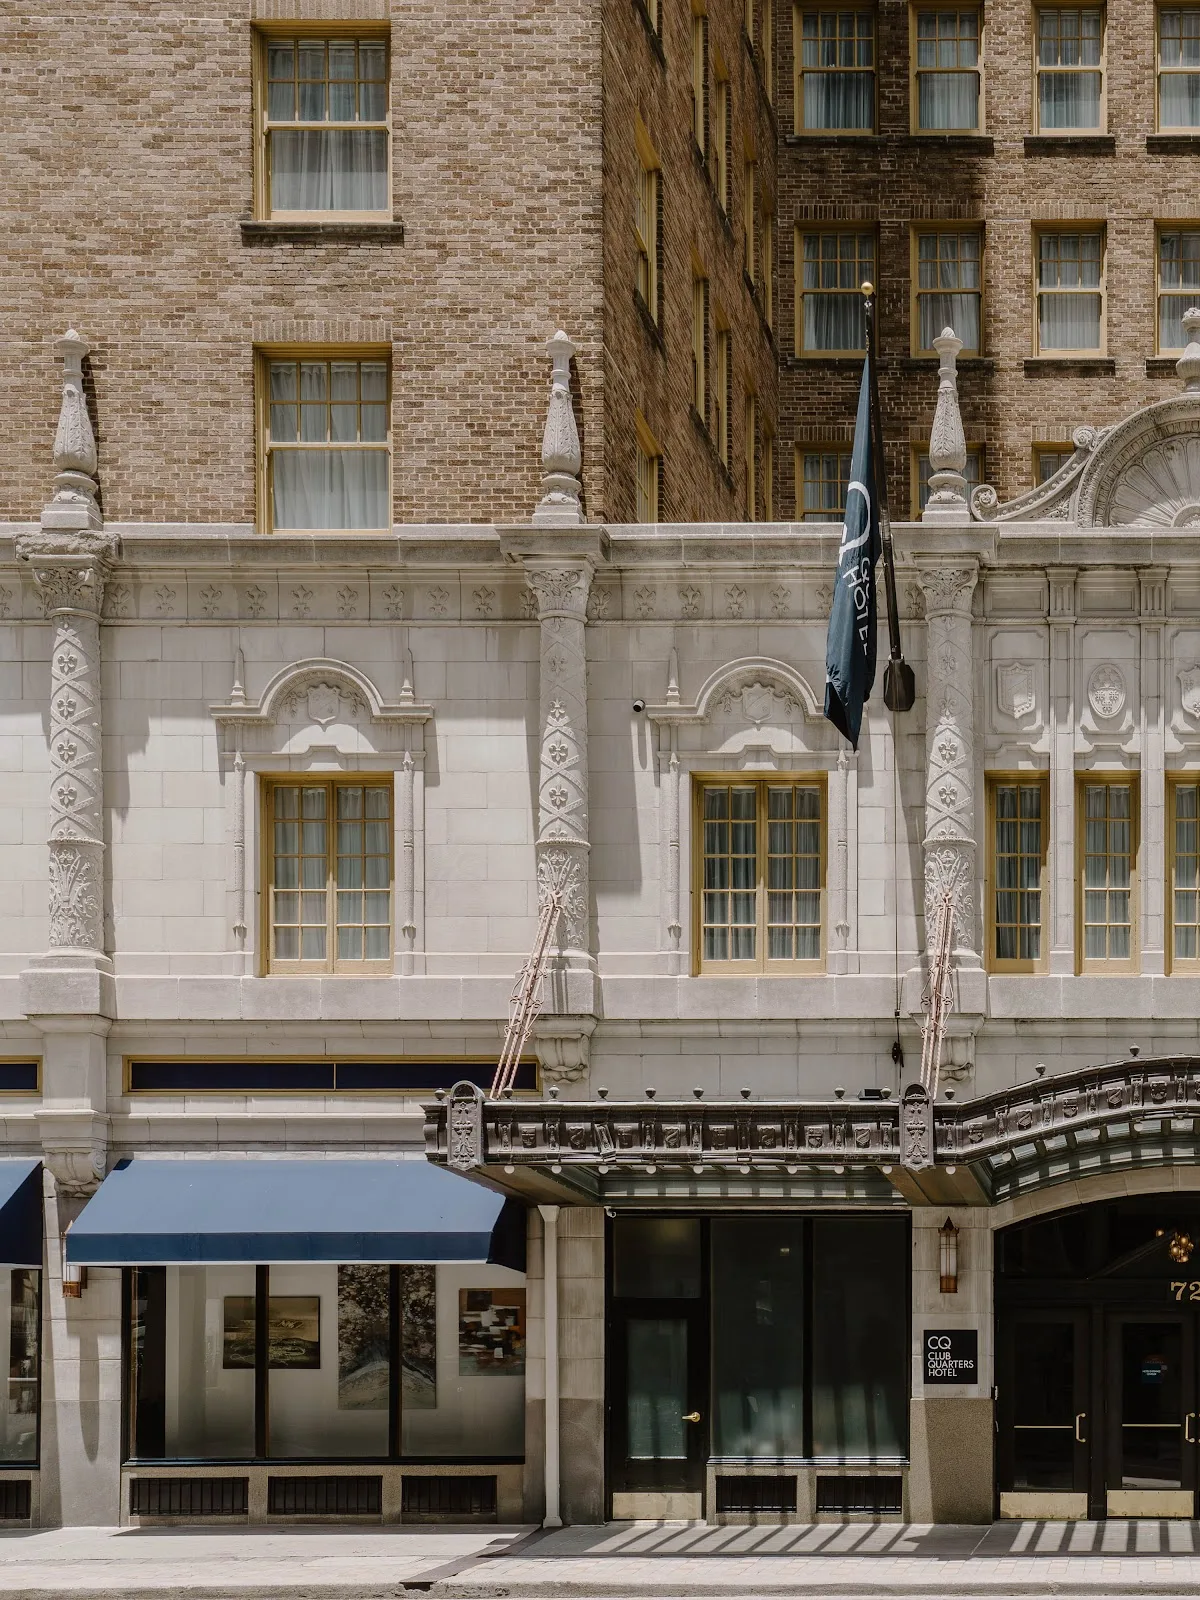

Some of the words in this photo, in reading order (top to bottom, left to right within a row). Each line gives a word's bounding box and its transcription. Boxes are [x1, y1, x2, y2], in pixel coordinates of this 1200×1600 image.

[927, 1335, 952, 1350] CQ
[927, 1351, 952, 1360] CLUB
[927, 1360, 974, 1369] QUARTERS
[928, 1368, 958, 1377] HOTEL
